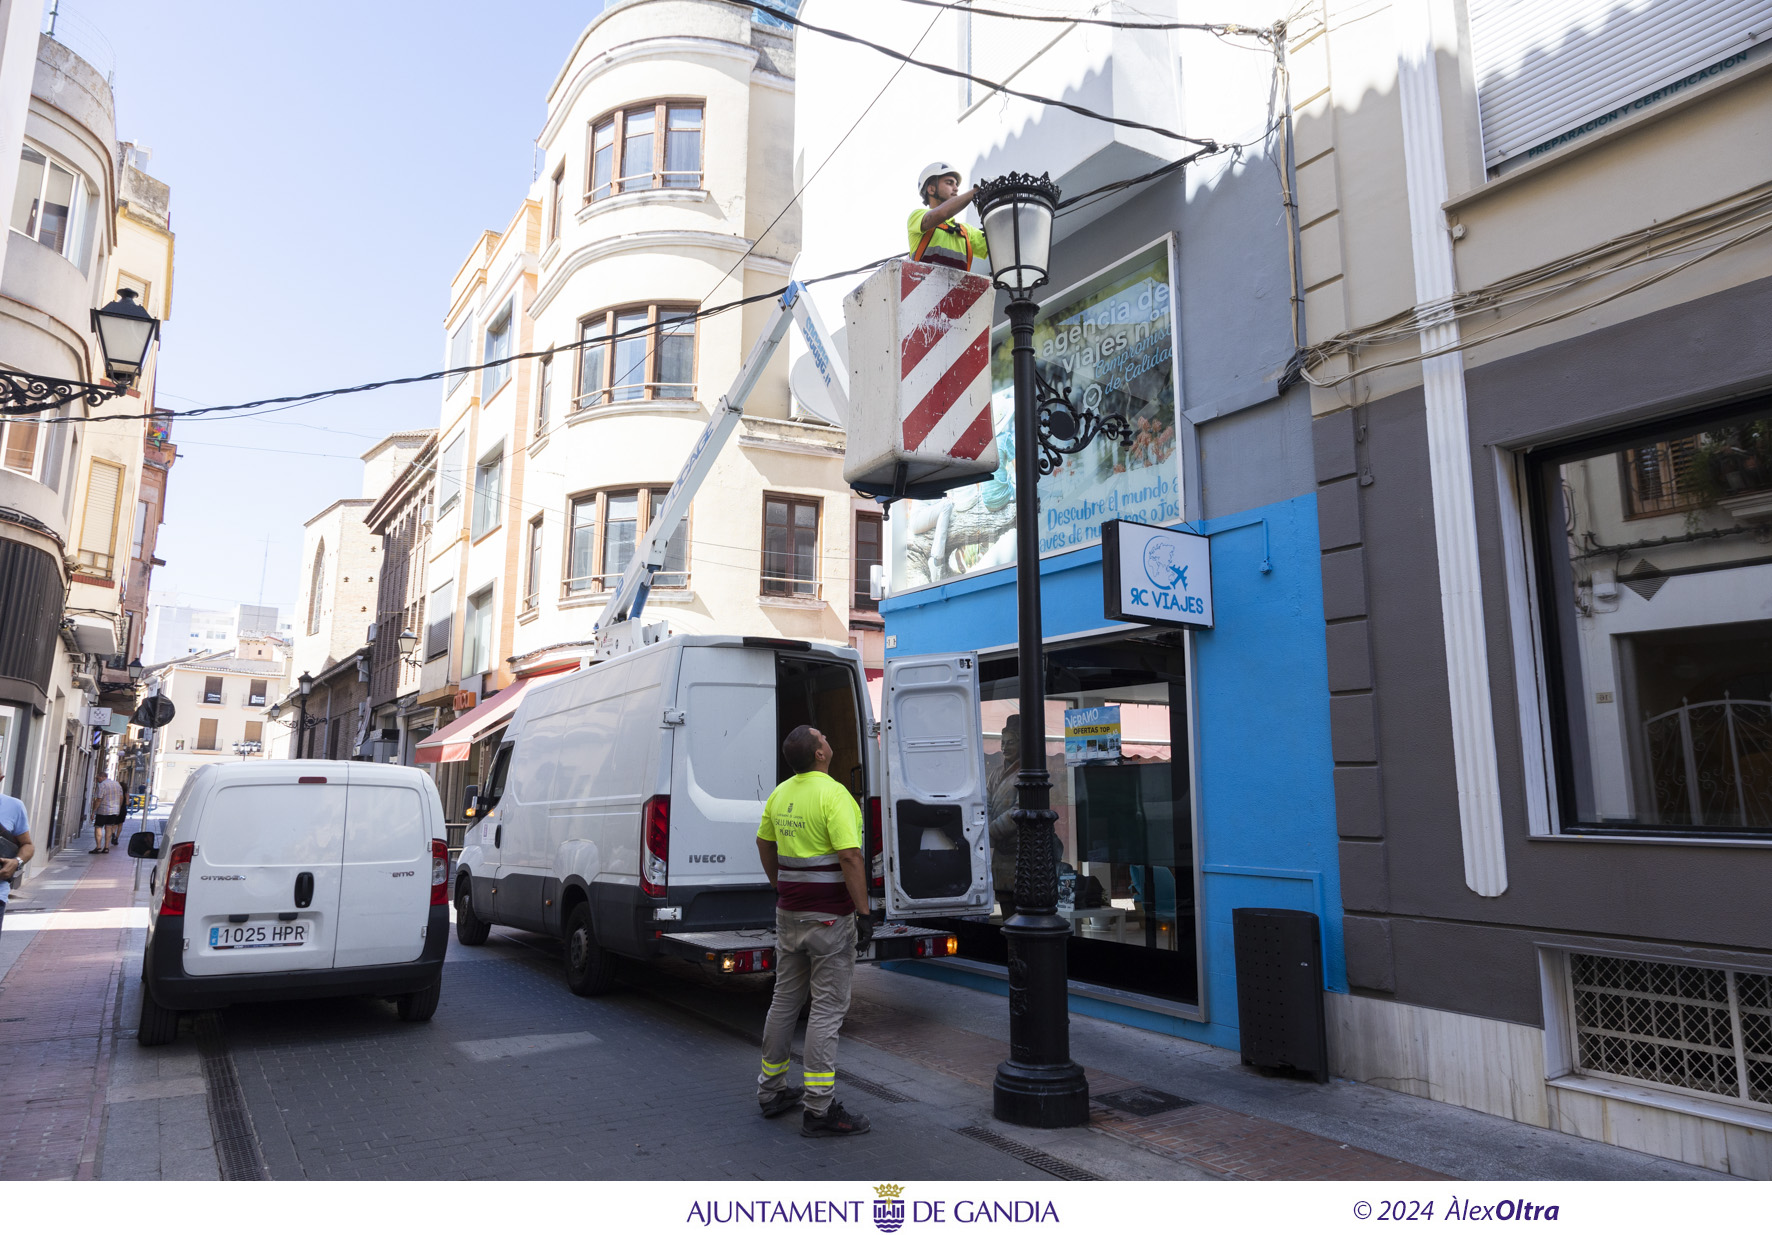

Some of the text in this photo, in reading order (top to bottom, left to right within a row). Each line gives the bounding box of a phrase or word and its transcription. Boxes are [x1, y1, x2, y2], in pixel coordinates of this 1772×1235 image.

[1042, 280, 1169, 357] agencia de
[1062, 330, 1128, 374] viajes
[1105, 374, 1121, 395] de
[1047, 499, 1105, 531] Descubre
[1108, 489, 1119, 512] el
[1122, 475, 1169, 507] mundo
[1068, 523, 1083, 544] de
[1151, 498, 1180, 523] ojos
[1151, 590, 1204, 615] VIAJES
[1065, 708, 1099, 729] VERANO
[1073, 726, 1098, 735] OFERTAS
[688, 854, 726, 864] IVECO
[223, 925, 305, 944] 1025 HPR
